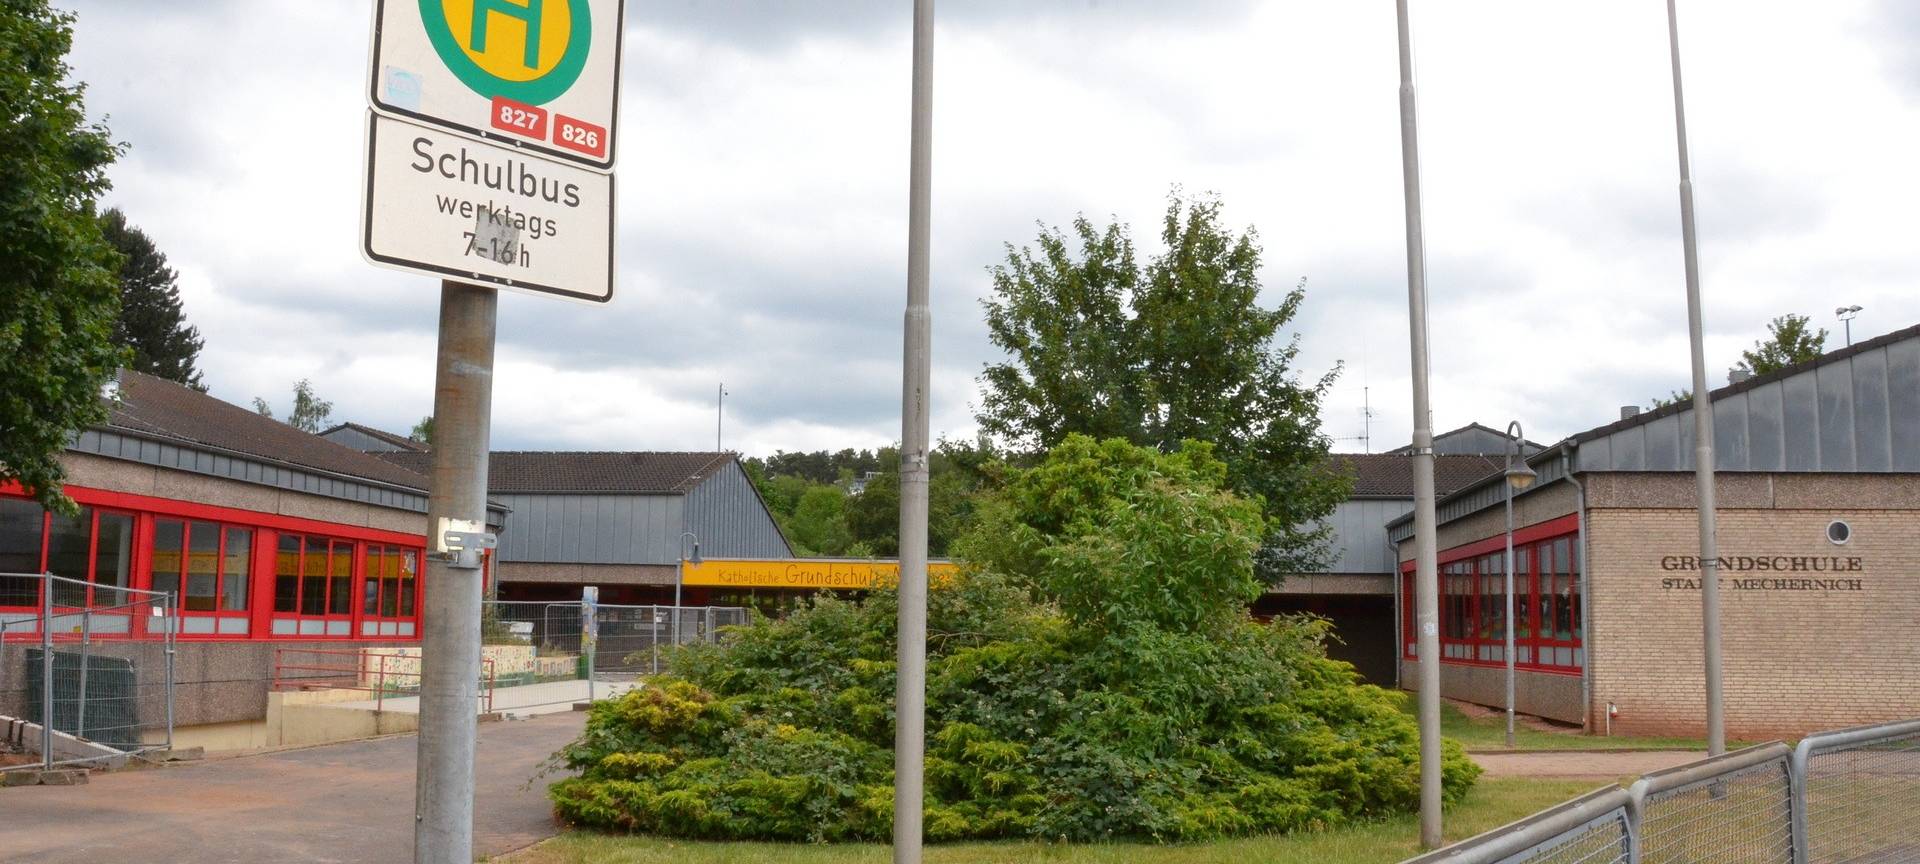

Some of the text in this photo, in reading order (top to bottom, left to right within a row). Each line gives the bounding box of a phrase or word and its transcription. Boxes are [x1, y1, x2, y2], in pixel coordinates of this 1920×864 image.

[500, 106, 539, 130] 827
[561, 124, 598, 148] 826
[411, 137, 580, 207] Schulbus
[436, 194, 557, 239] werktags
[1661, 556, 1862, 572] GRNDSCHULE
[718, 569, 780, 585] Katholische
[1662, 577, 1862, 591] STA MECHERNICH
